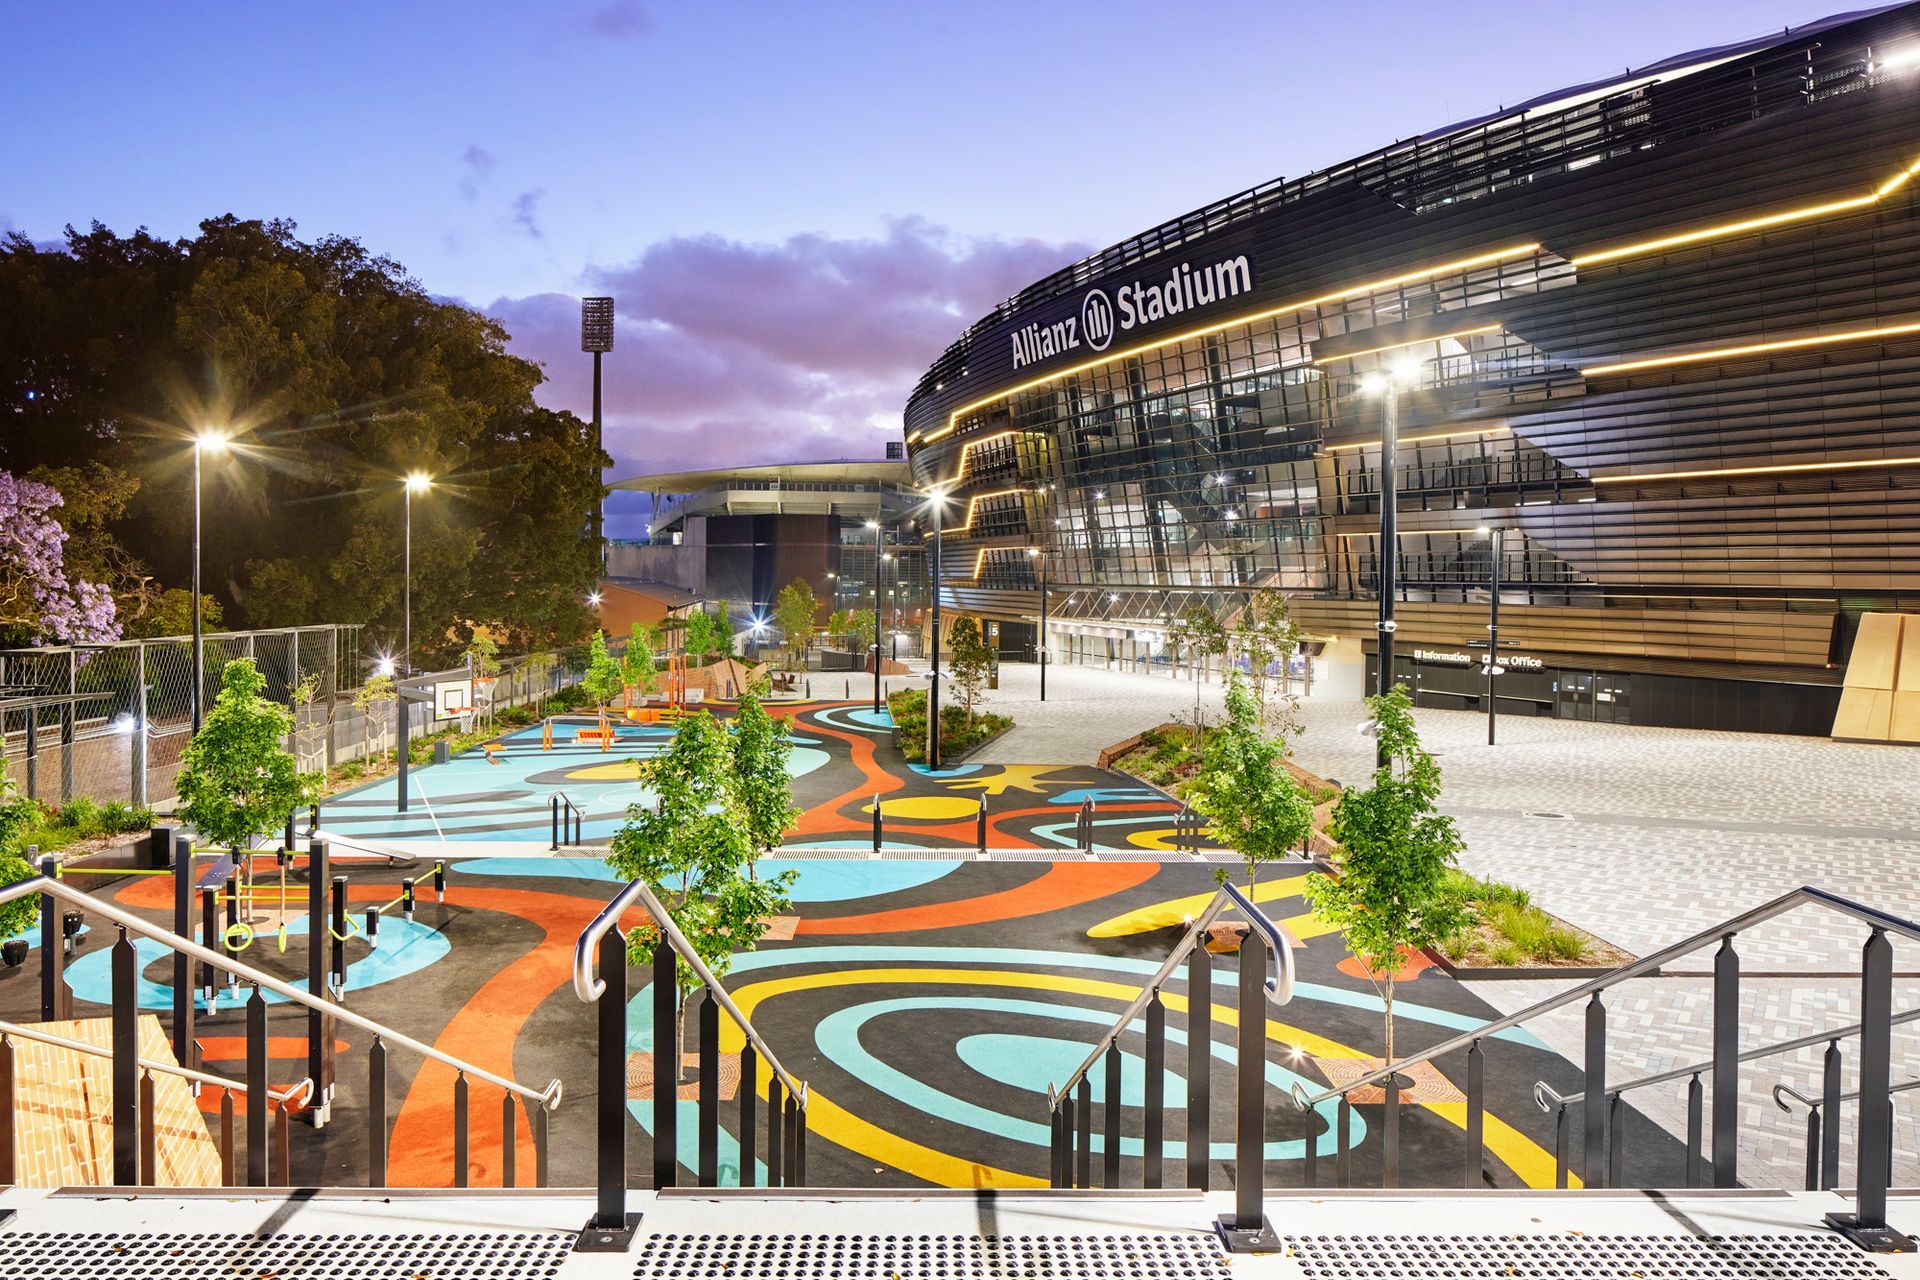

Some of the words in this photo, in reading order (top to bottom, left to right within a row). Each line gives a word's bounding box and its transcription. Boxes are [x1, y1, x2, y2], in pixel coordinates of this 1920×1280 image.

[1011, 316, 1080, 370] Allianz
[1117, 255, 1252, 330] Stadium
[991, 627, 998, 636] 5
[1423, 650, 1471, 662] Information
[1510, 656, 1542, 667] Office
